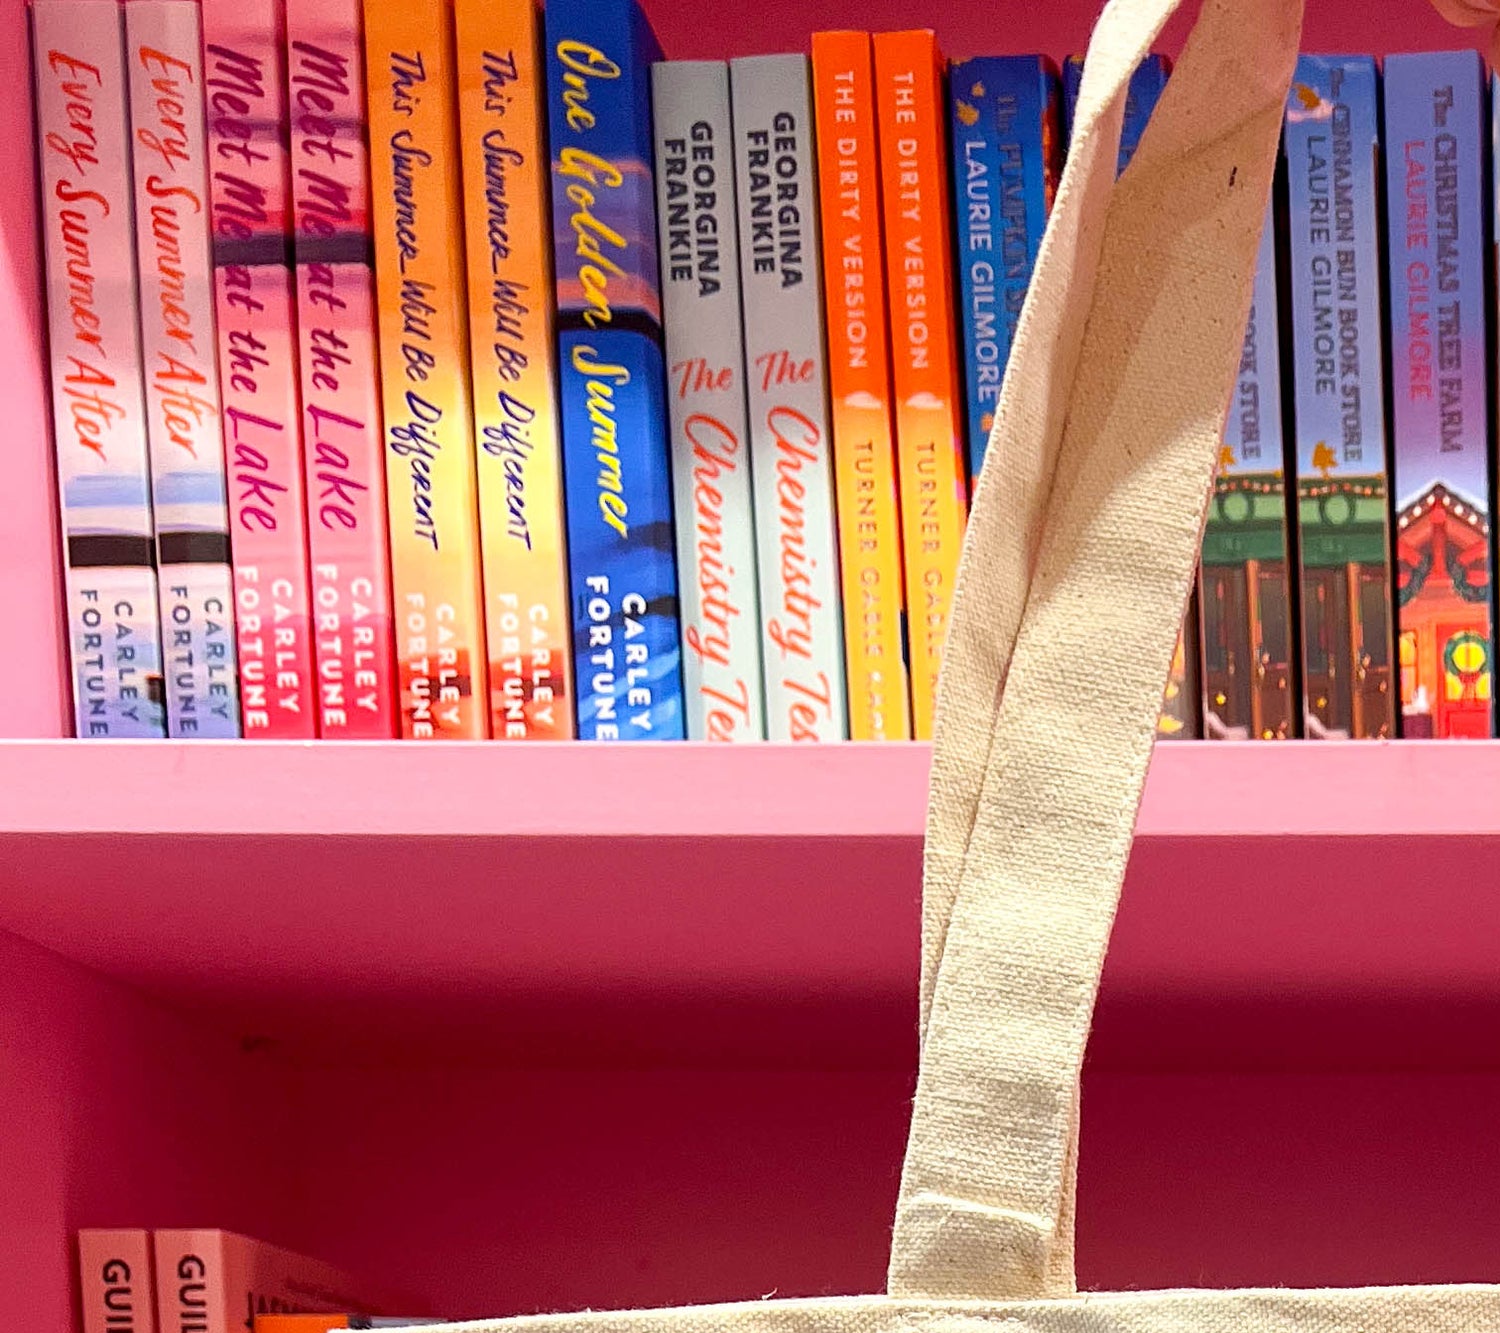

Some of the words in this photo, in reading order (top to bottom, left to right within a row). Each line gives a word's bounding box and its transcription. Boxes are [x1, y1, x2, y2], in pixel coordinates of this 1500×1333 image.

[46, 50, 102, 176] Every
[207, 45, 269, 167] Meet
[391, 51, 425, 116] This
[557, 40, 620, 131] One
[835, 71, 855, 123] THE
[215, 172, 267, 240] Me
[391, 130, 432, 274] Summer
[557, 148, 628, 329] Golden
[665, 139, 692, 281] FRANKIE
[691, 121, 720, 298] GEORGINA
[838, 139, 860, 220] DIRTY
[966, 141, 992, 252] LAURIE
[1307, 136, 1330, 245] LAURIE
[55, 180, 110, 359] Summer
[402, 280, 436, 340] Will
[844, 235, 868, 368] VERSION
[971, 262, 1000, 404] GILMORE
[1311, 255, 1335, 396] GILMORE
[63, 354, 126, 461] After
[229, 330, 270, 393] the
[402, 343, 434, 382] Be
[673, 357, 733, 398] The
[227, 406, 288, 532] Lake
[391, 391, 442, 550] Different
[572, 346, 630, 539] Summer
[855, 440, 877, 553] TURNER
[685, 415, 739, 666] Chemistry
[81, 590, 108, 735] FORTUNE
[115, 601, 139, 721] CARLEY
[238, 566, 268, 728] FORTUNE
[272, 579, 300, 712] CARLEY
[316, 564, 346, 726] FORTUNE
[351, 578, 378, 711] CARLEY
[406, 594, 433, 737] FORTUNE
[436, 604, 459, 723] CARLEY
[586, 576, 618, 741] FORTUNE
[622, 593, 651, 730] CARLEY
